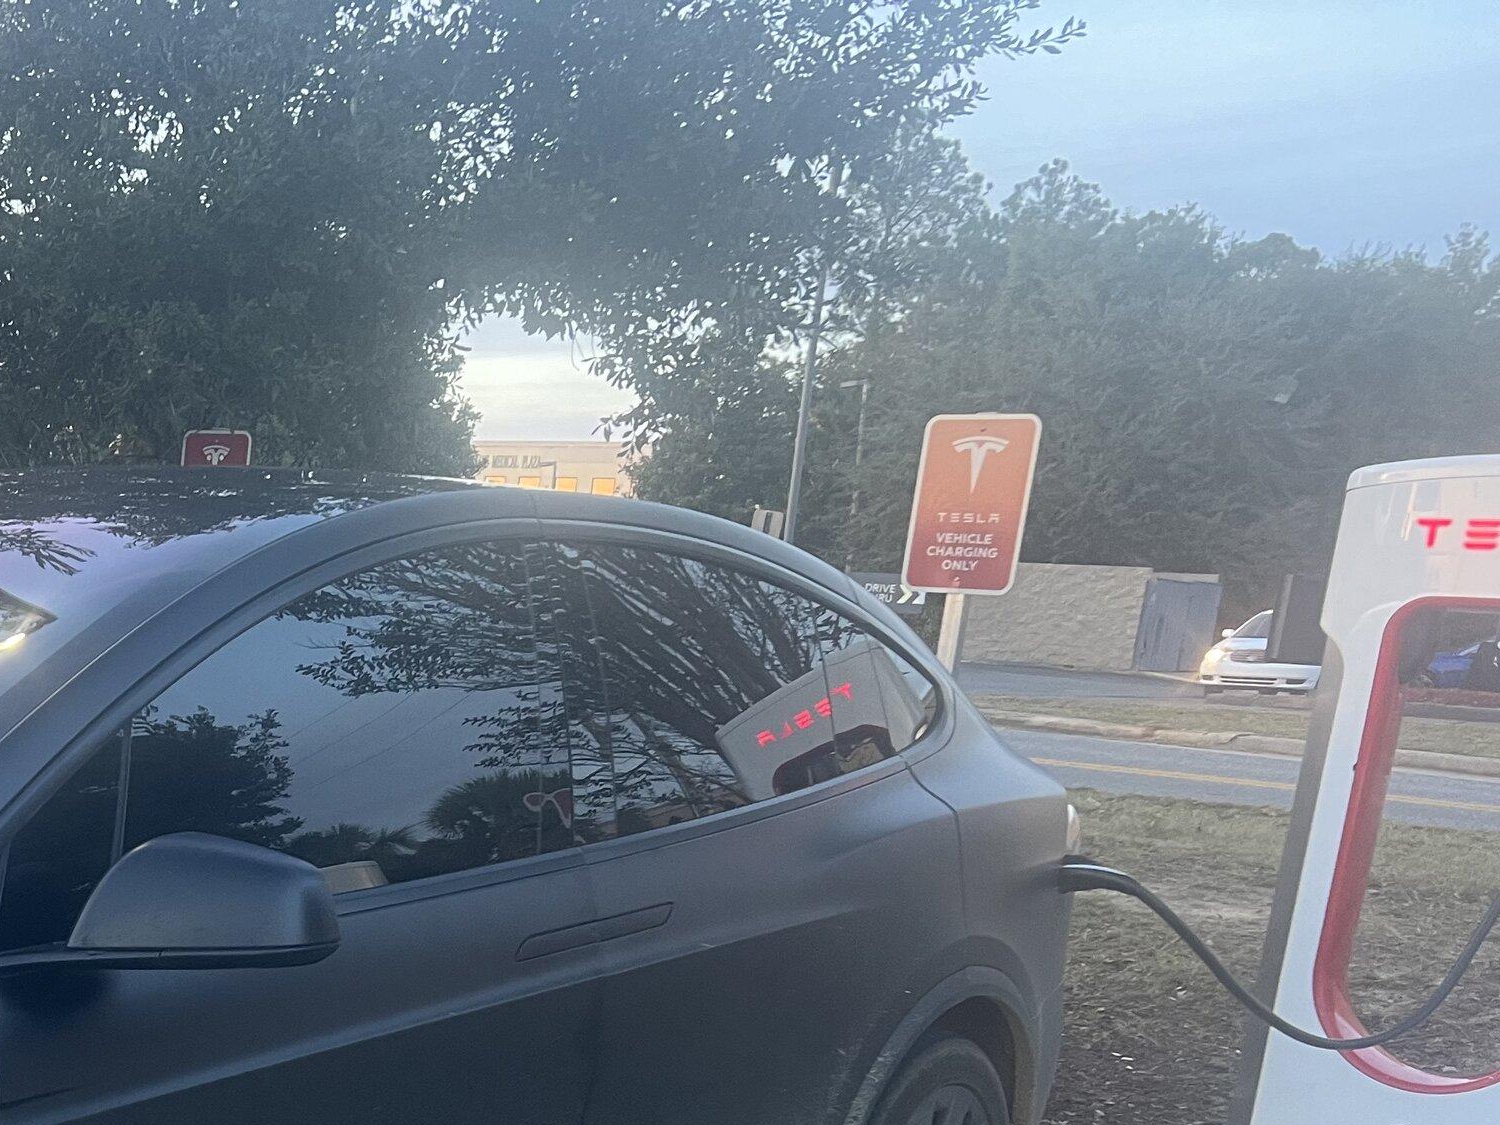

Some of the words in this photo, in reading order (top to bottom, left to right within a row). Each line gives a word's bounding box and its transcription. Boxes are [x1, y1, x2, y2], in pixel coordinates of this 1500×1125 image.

[937, 512, 1000, 523] TESLA
[936, 532, 993, 544] VEHICLE
[926, 545, 999, 558] CHARGING
[941, 560, 979, 571] ONLY
[865, 583, 896, 593] DRIVE
